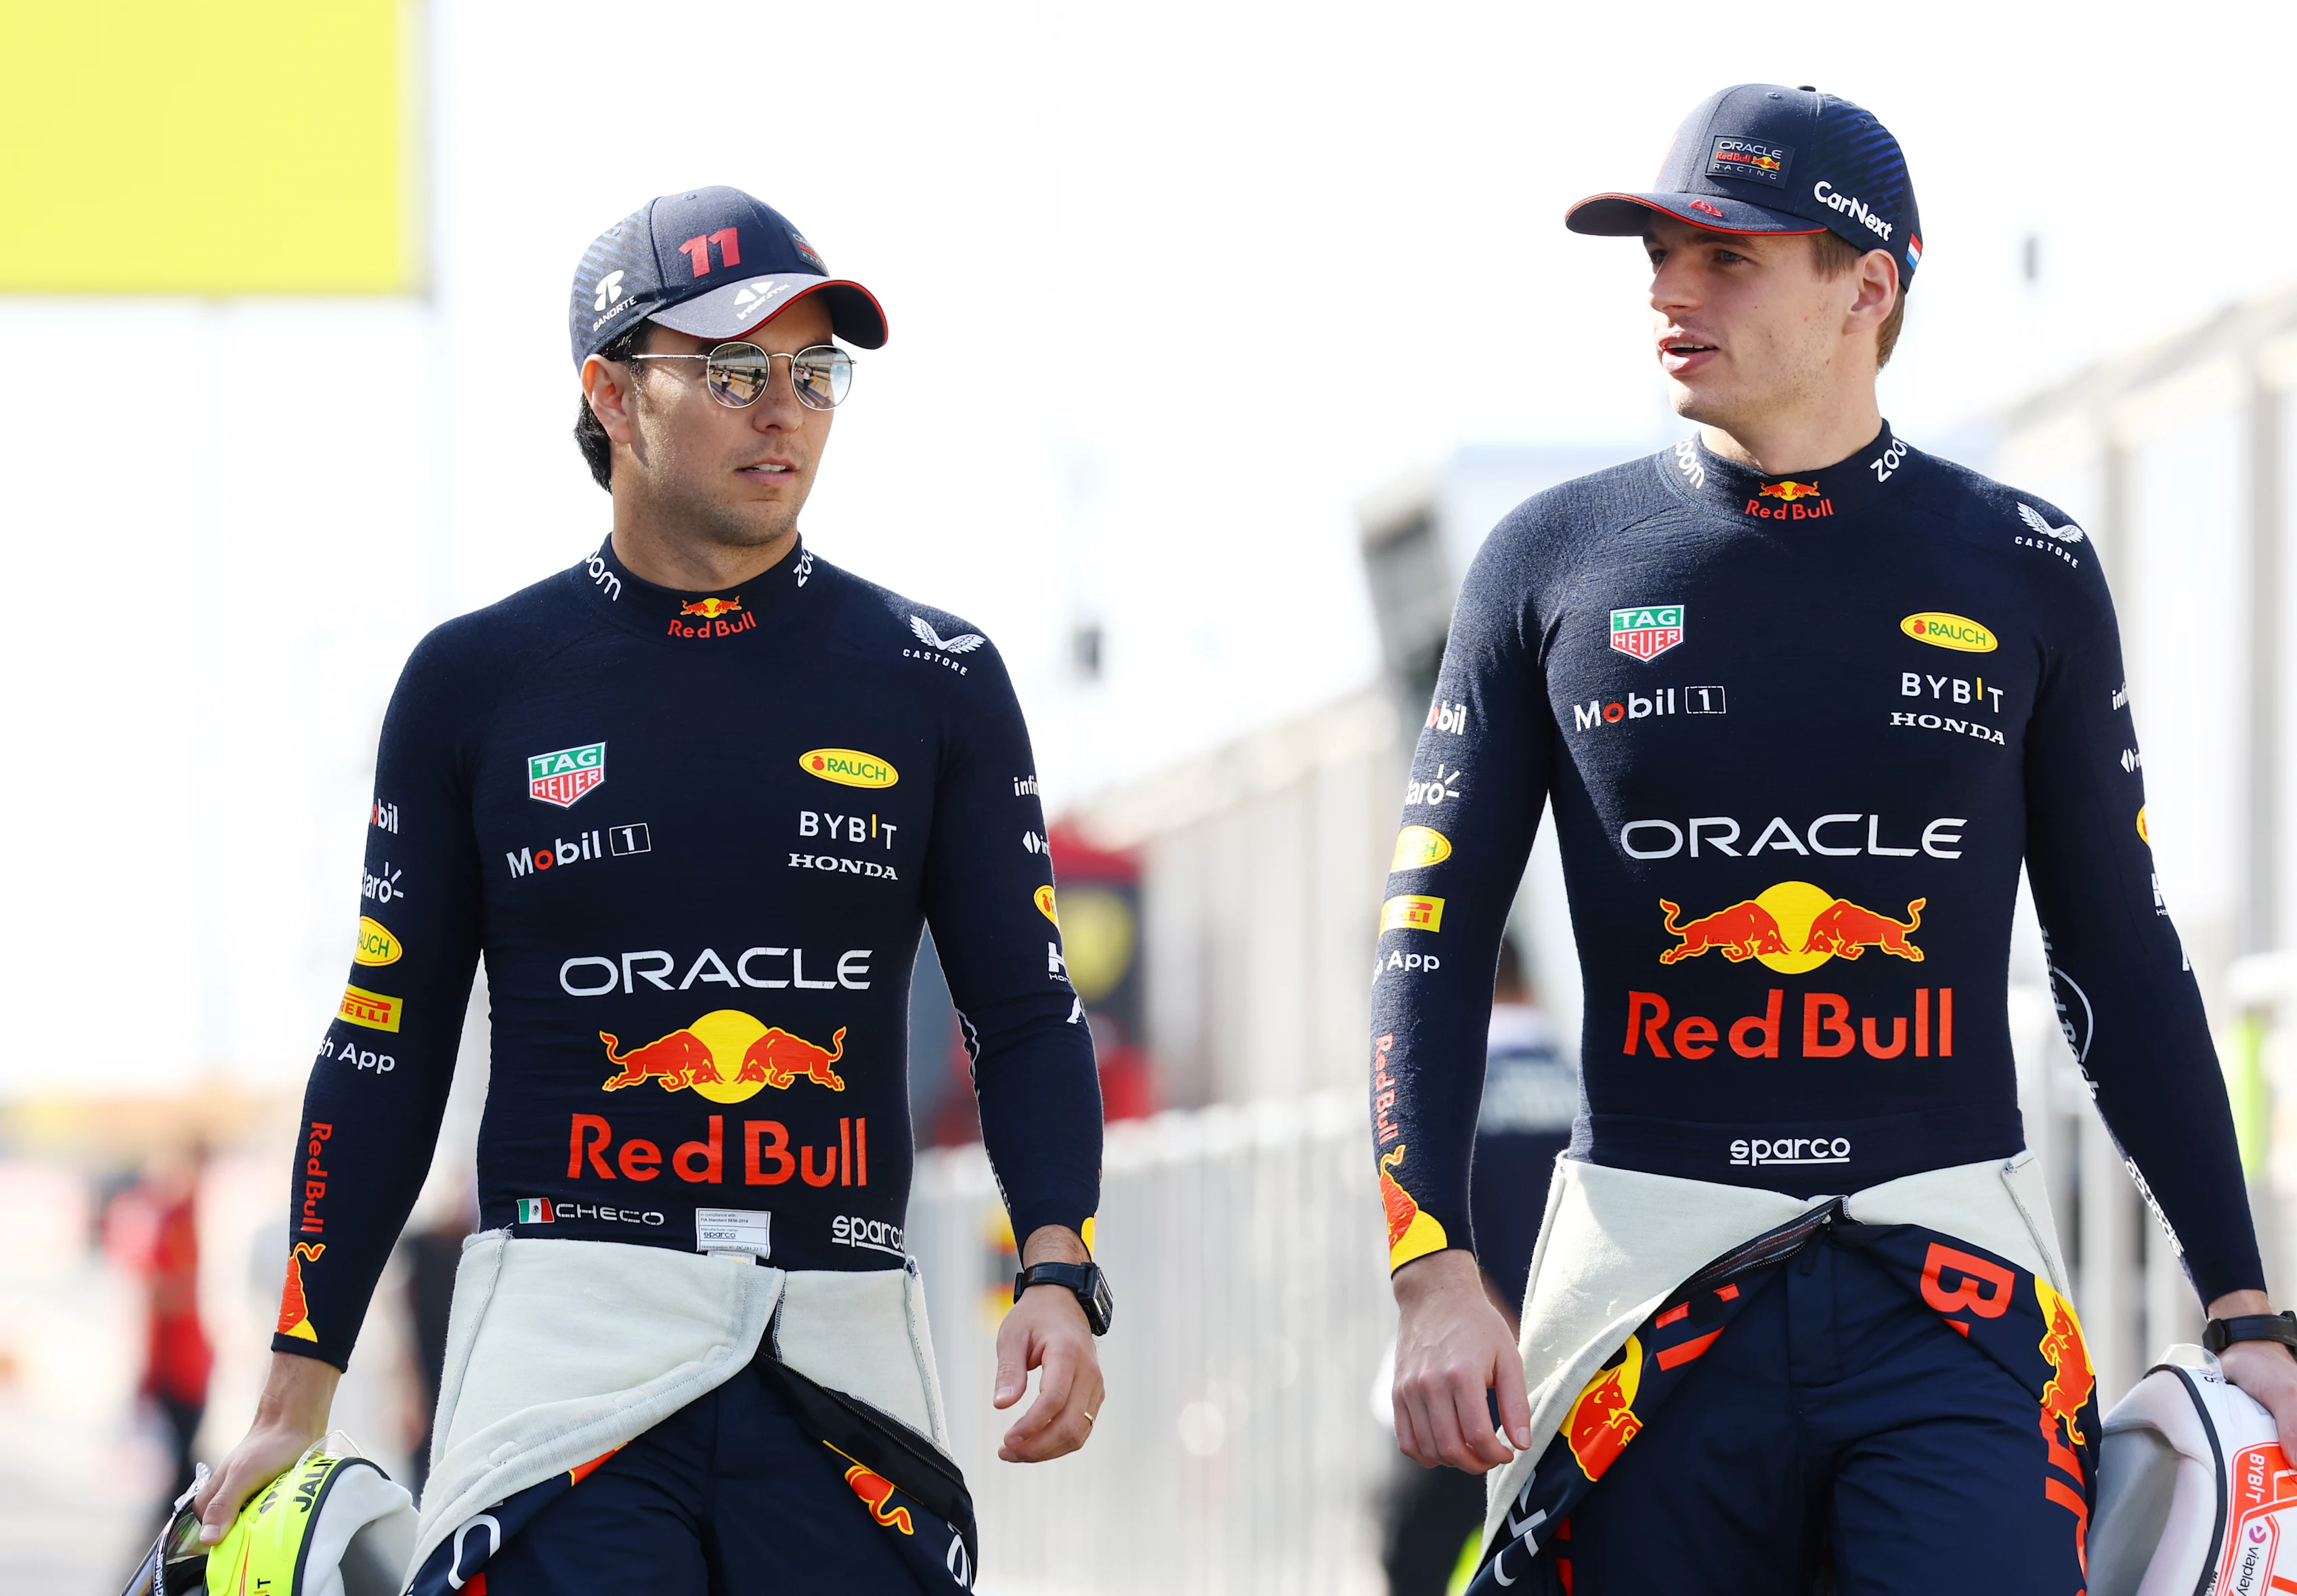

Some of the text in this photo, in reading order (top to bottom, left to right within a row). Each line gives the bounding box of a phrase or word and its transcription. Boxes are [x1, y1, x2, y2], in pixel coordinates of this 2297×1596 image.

[1715, 151, 1751, 163] Red Bull
[1719, 141, 1782, 159] ORACLE
[1713, 163, 1777, 180] RACING
[1813, 181, 1893, 242] CarNext
[679, 227, 740, 278] 11
[593, 295, 637, 332] BANORTE
[1675, 437, 1704, 489] oom
[1870, 438, 1908, 483] zoo
[1744, 499, 1834, 520] Red Bull
[2015, 536, 2078, 568] CASTORE
[667, 611, 757, 638] Red Bull
[1616, 609, 1676, 628] TAG
[1929, 621, 1985, 646] RAUCH
[1615, 630, 1677, 656] HEUER
[903, 649, 968, 676] CASTORE
[1902, 672, 2003, 713] BYBIT
[1426, 699, 1467, 735] obil
[1574, 688, 1711, 731] Mobil 1
[1889, 712, 2005, 745] HONDA
[534, 748, 597, 775] TAG
[828, 758, 886, 781] RAUCH
[534, 770, 599, 802] HEUER
[1405, 777, 1444, 805] laro
[370, 798, 398, 834] obil
[800, 811, 897, 850] BYBIT
[1620, 813, 1968, 859] ORACLE
[506, 827, 635, 879] Mobil 1
[788, 853, 898, 880] HONDA
[362, 867, 392, 903] laro
[358, 929, 390, 957] AUCH
[559, 947, 873, 996] ORACLE
[1387, 950, 1440, 972] App
[339, 999, 389, 1023] RELLI
[1623, 987, 1952, 1060] Red Bull
[338, 1042, 395, 1074] App
[1375, 1033, 1398, 1144] Red Bull
[567, 1113, 867, 1187] Red Bull
[1730, 1138, 1851, 1166] sparco
[301, 1121, 332, 1233] Red Bull
[556, 1203, 664, 1226] CHECO
[832, 1215, 904, 1251] sparco
[2245, 1452, 2265, 1503] BYBIT
[2237, 1547, 2258, 1596] viaplay
